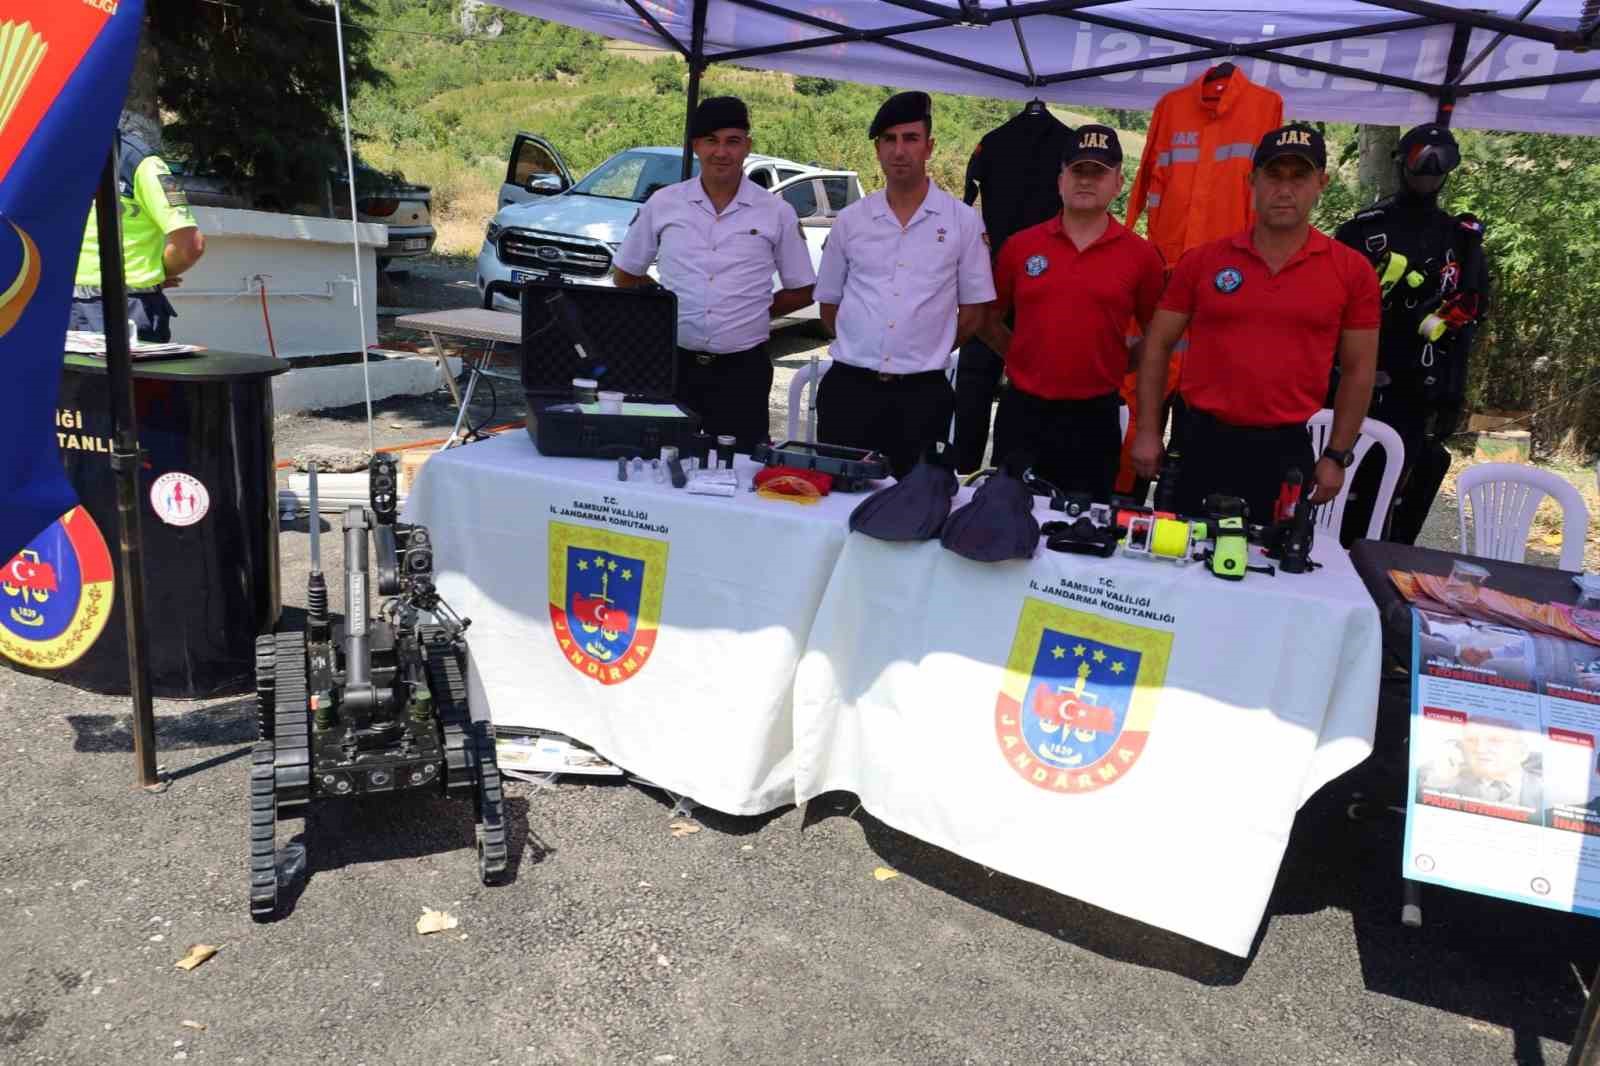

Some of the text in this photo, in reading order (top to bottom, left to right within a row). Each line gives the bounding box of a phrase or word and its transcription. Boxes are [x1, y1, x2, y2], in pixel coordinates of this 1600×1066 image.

[1079, 132, 1109, 149] JAK
[1276, 130, 1311, 146] JAK
[573, 500, 610, 514] SAMSUN
[603, 496, 619, 505] T.C.
[550, 505, 558, 514] İL
[560, 507, 607, 522] JANDARMA
[1099, 577, 1116, 588] T.C.
[1029, 579, 1176, 624] İL JANDARMA KOMUTANLIĞI
[1060, 578, 1151, 608] SAMSUN VALİLİĞİ
[1001, 713, 1135, 789] JANDARMA
